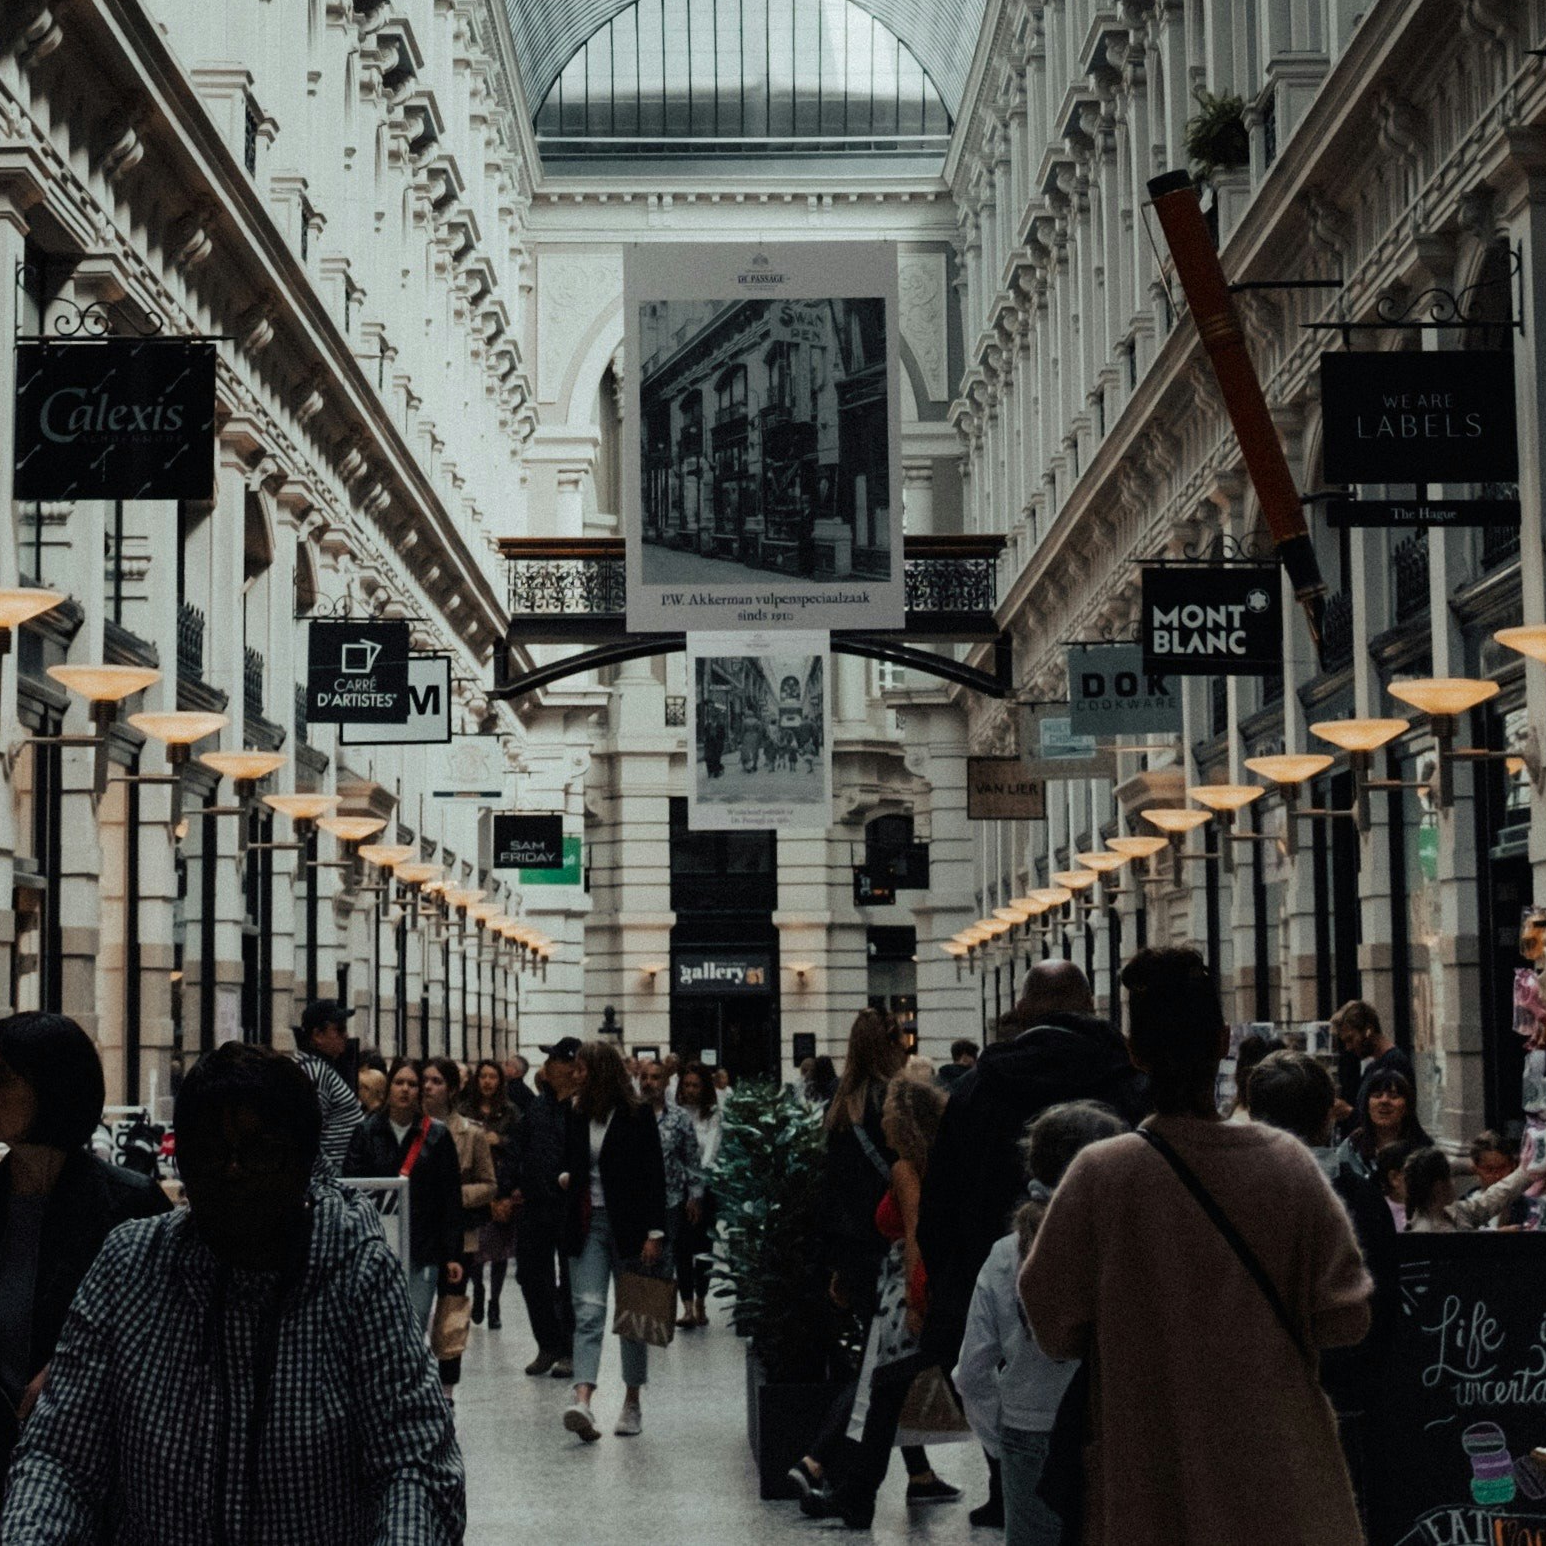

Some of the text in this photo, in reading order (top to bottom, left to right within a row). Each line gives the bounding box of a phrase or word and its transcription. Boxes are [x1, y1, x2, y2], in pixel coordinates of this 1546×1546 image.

[1382, 392, 1454, 409] WE ARE
[39, 386, 184, 443] Calexis
[1357, 412, 1482, 439] LABELS
[1390, 506, 1458, 521] The Hague
[689, 593, 752, 605] Akkerman
[755, 592, 870, 608] vulpenspeciaalzaak
[738, 609, 767, 621] sinds
[1152, 604, 1246, 629] MONT
[1153, 629, 1246, 655] BLANC
[333, 675, 377, 692] CARRÉ
[1081, 671, 1170, 698] DOK
[1076, 698, 1177, 712] COOKWARE
[976, 783, 1038, 795] VAN LIER
[510, 840, 545, 851] SAM
[500, 852, 556, 862] FRIDAY
[679, 961, 746, 985] gallery
[1421, 1295, 1506, 1387] Life
